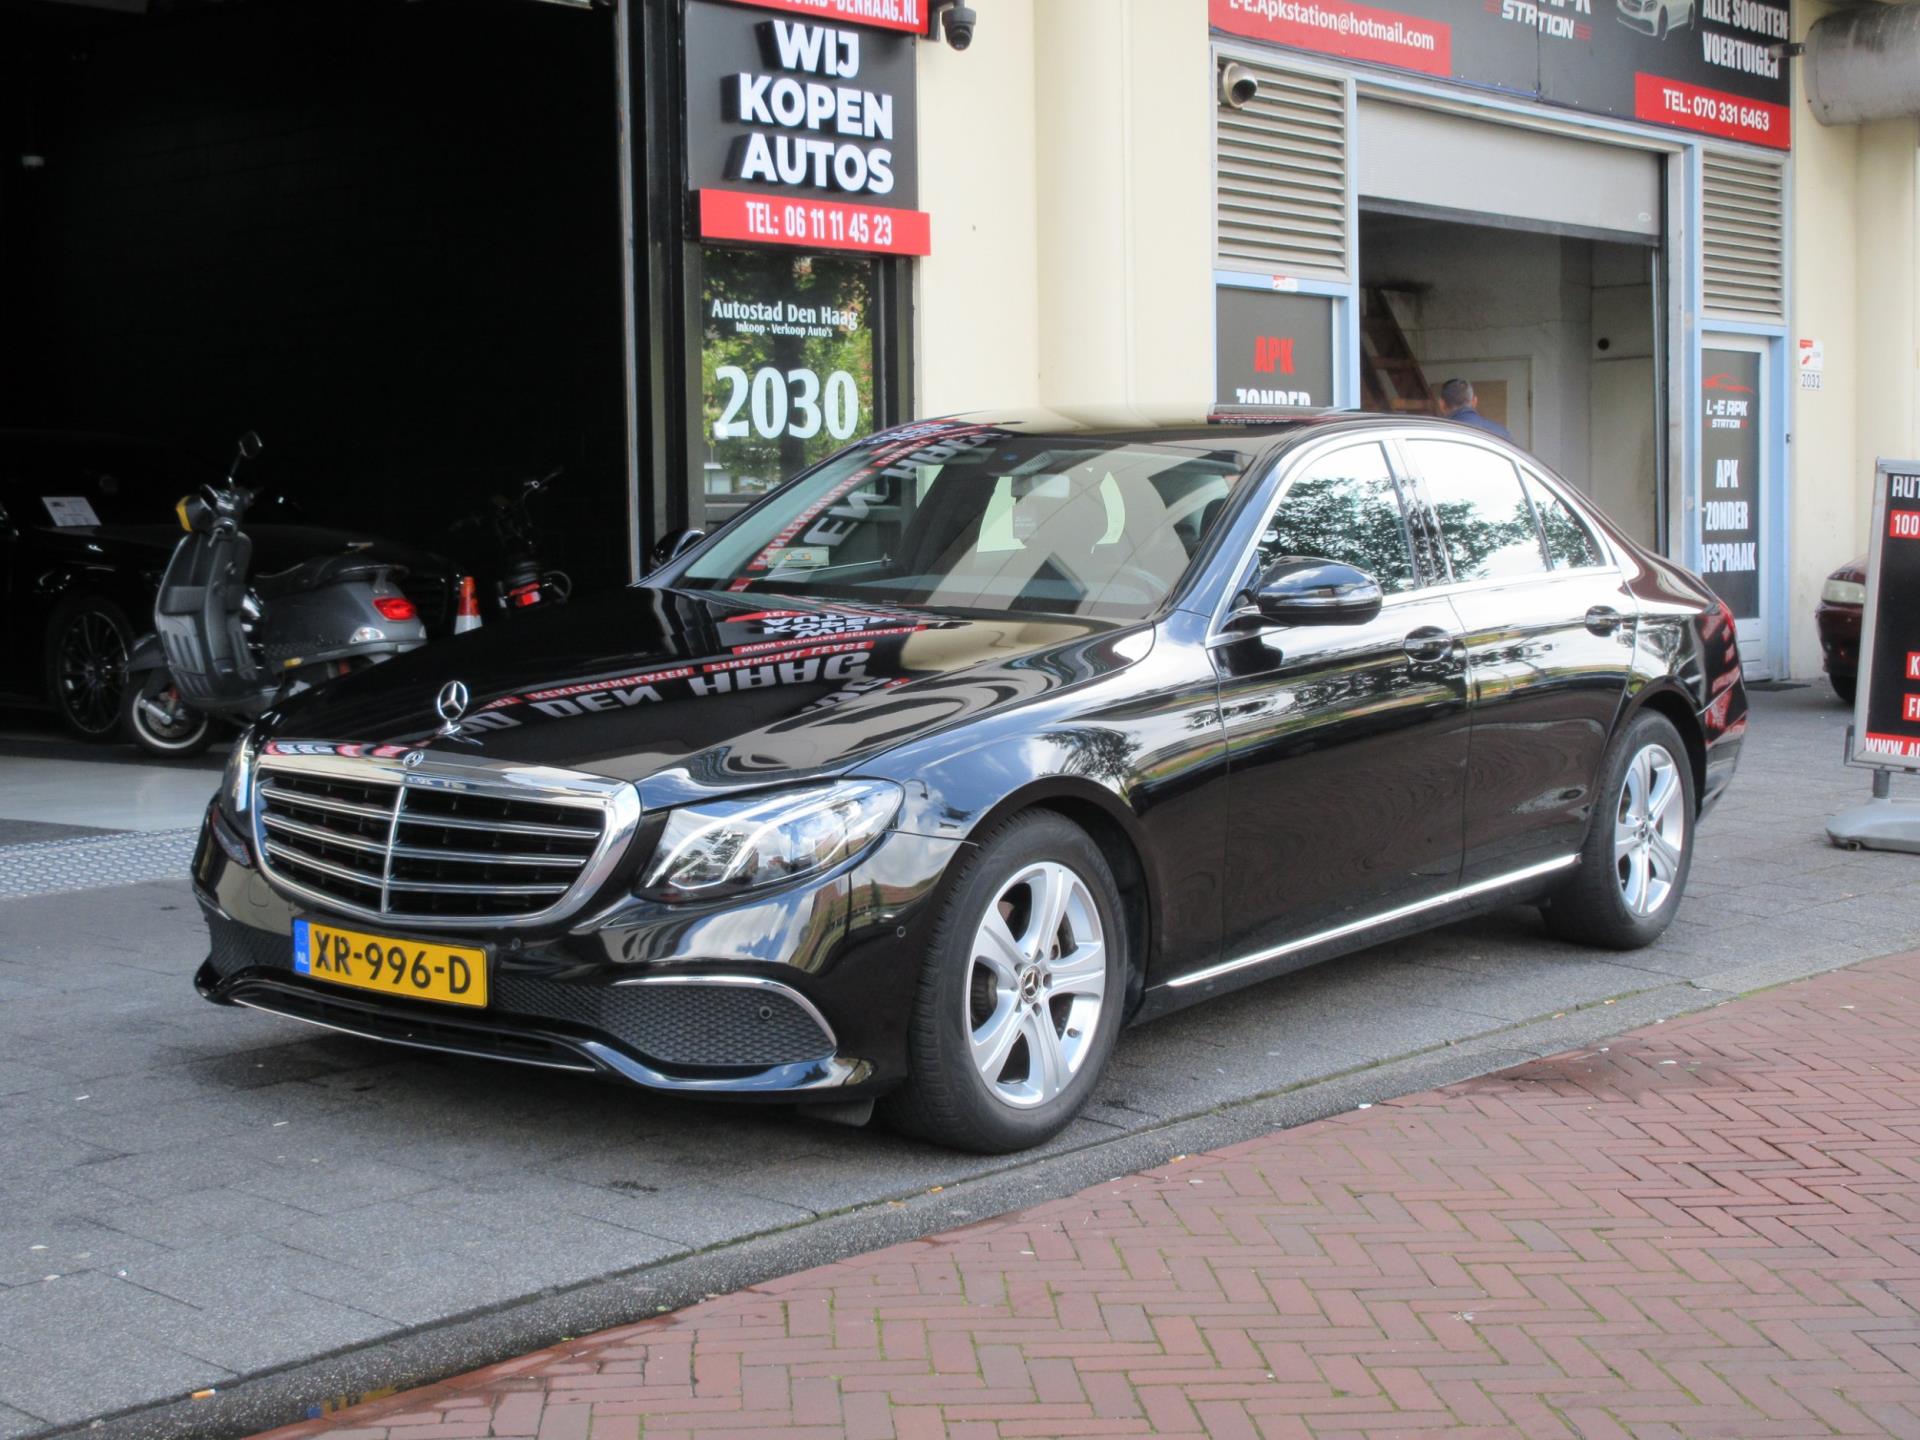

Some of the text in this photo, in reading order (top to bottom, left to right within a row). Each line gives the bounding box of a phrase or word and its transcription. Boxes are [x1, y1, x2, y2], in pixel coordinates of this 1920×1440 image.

[1502, 0, 1575, 39] STATION
[1703, 0, 1788, 40] ALLE SOORTEN
[773, 19, 860, 78] WIJ
[739, 72, 893, 139] KOPEN
[1663, 88, 1769, 132] TEL: 070 331 6463
[740, 132, 895, 194] AUTOS
[746, 201, 893, 246] TEL: 06 11 11 45 23
[711, 299, 858, 330] Autostad Den Haag
[736, 321, 765, 336] Inkoop
[771, 324, 806, 338] Verkoop
[807, 326, 833, 338] Auto's
[1254, 335, 1296, 375] APK
[713, 366, 859, 440] 2030
[1716, 459, 1739, 488] APK
[1706, 501, 1748, 530] ZONDER
[1701, 543, 1756, 573] AFSPRAAK
[315, 930, 471, 994] XR-996-D
